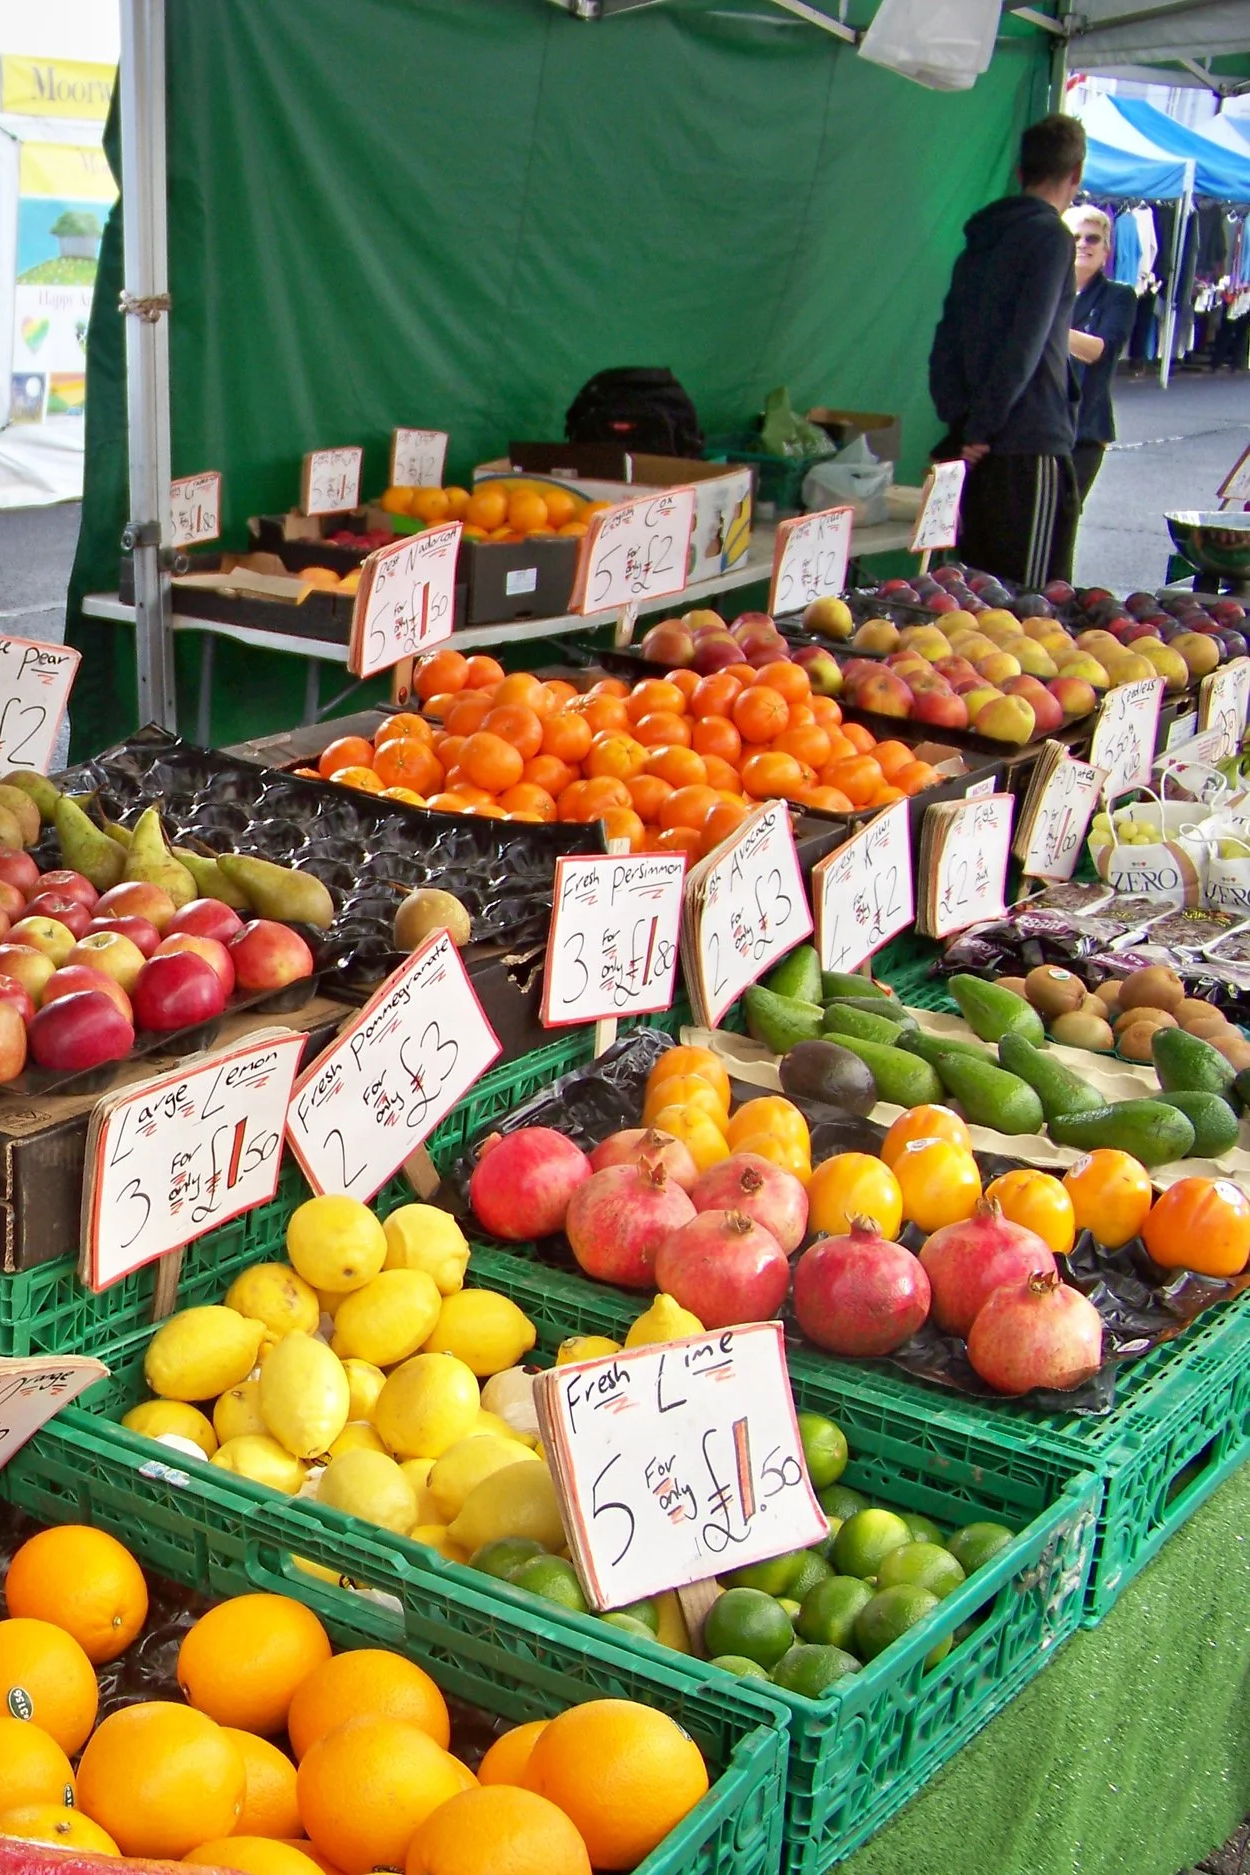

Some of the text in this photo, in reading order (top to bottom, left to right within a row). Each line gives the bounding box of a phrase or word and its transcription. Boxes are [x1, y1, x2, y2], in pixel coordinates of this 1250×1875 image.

[645, 496, 673, 527] Cox
[594, 544, 623, 602] 5
[631, 535, 674, 593] £2
[369, 602, 390, 664] 5
[403, 581, 449, 653] £1.50
[17, 647, 70, 680] Pear
[730, 813, 777, 893] Avocado
[863, 818, 891, 871] Kiwi
[1111, 868, 1178, 892] ZERO
[561, 860, 683, 913] Fresh Persimmon
[829, 914, 851, 973] 4
[867, 865, 902, 946] £2
[562, 932, 589, 1004] 3
[708, 932, 729, 997] 2
[753, 868, 792, 961] £3
[110, 1051, 279, 1168] Large Lemon
[297, 1063, 343, 1134] Fresh
[323, 1128, 368, 1189] 2
[375, 1091, 406, 1124] only
[400, 1021, 459, 1128] £3
[116, 1178, 151, 1249] 3
[168, 1173, 201, 1202] only
[191, 1116, 280, 1224] £1.50
[566, 1330, 735, 1434] Fresh Lime
[592, 1453, 635, 1567] 5
[658, 1477, 699, 1521] only
[703, 1416, 802, 1553] £1.50
